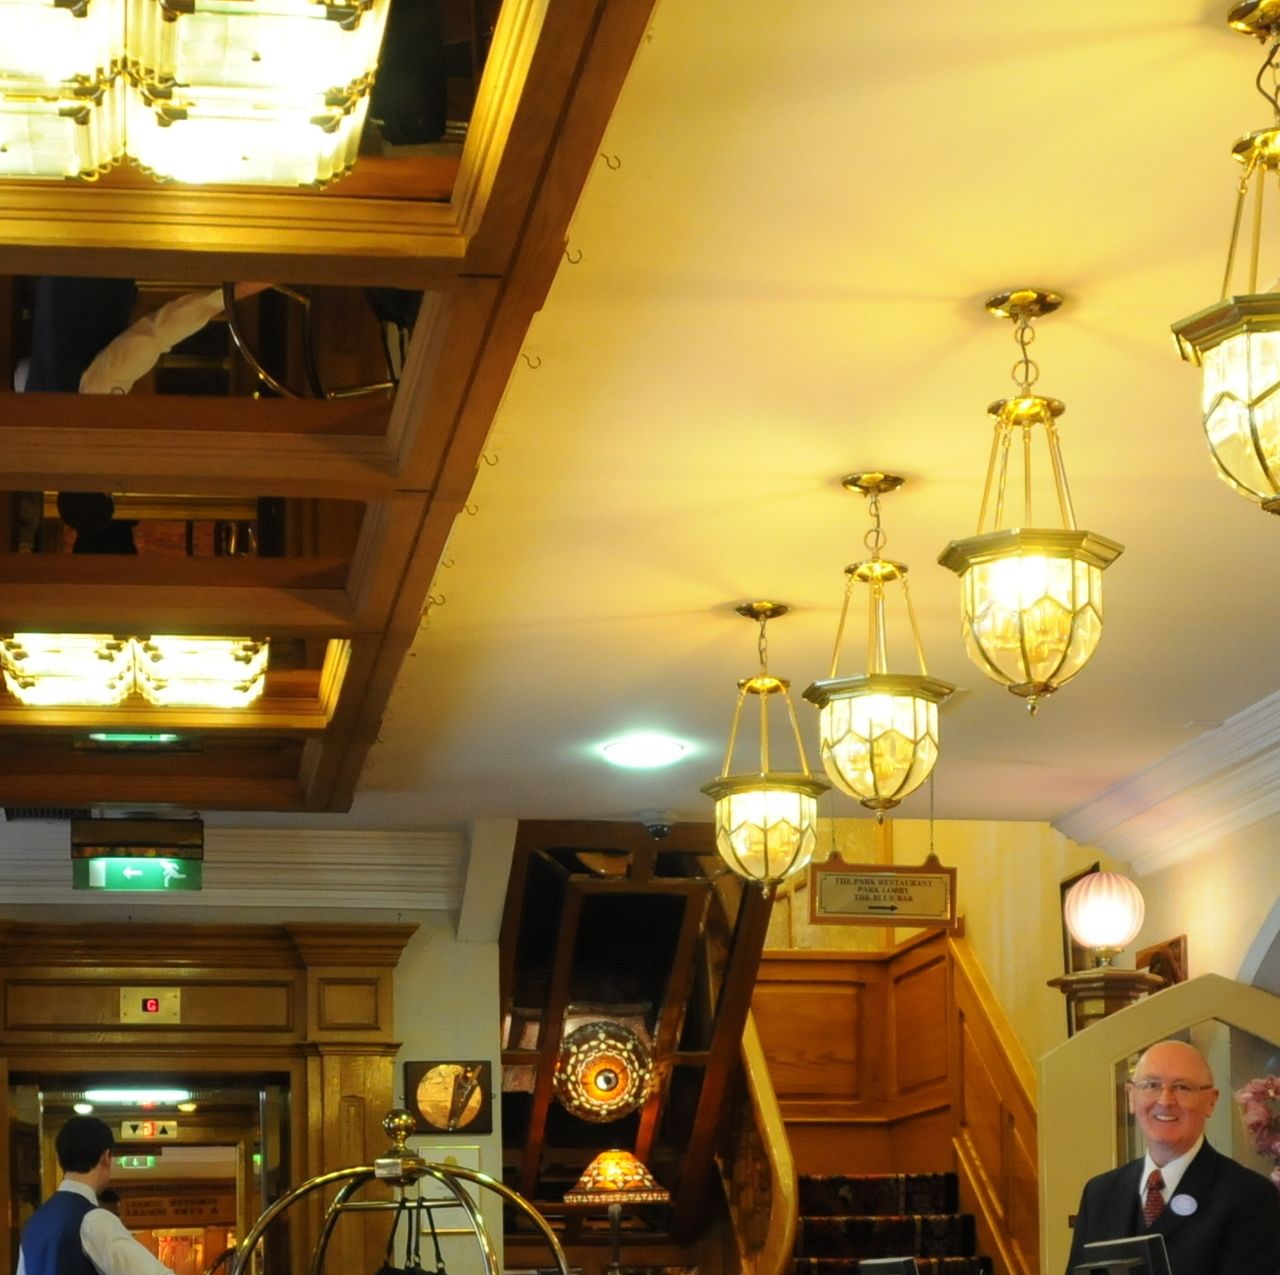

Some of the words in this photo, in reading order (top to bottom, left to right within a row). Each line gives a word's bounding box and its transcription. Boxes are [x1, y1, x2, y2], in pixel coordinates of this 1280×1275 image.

[835, 877, 851, 886] THE
[854, 878, 876, 887] PARK
[878, 879, 933, 888] RESTAURANT
[858, 886, 880, 894] PARK
[882, 886, 909, 895] LOBBY
[854, 893, 871, 902] THE
[897, 894, 914, 903] BAR
[147, 999, 157, 1011] G
